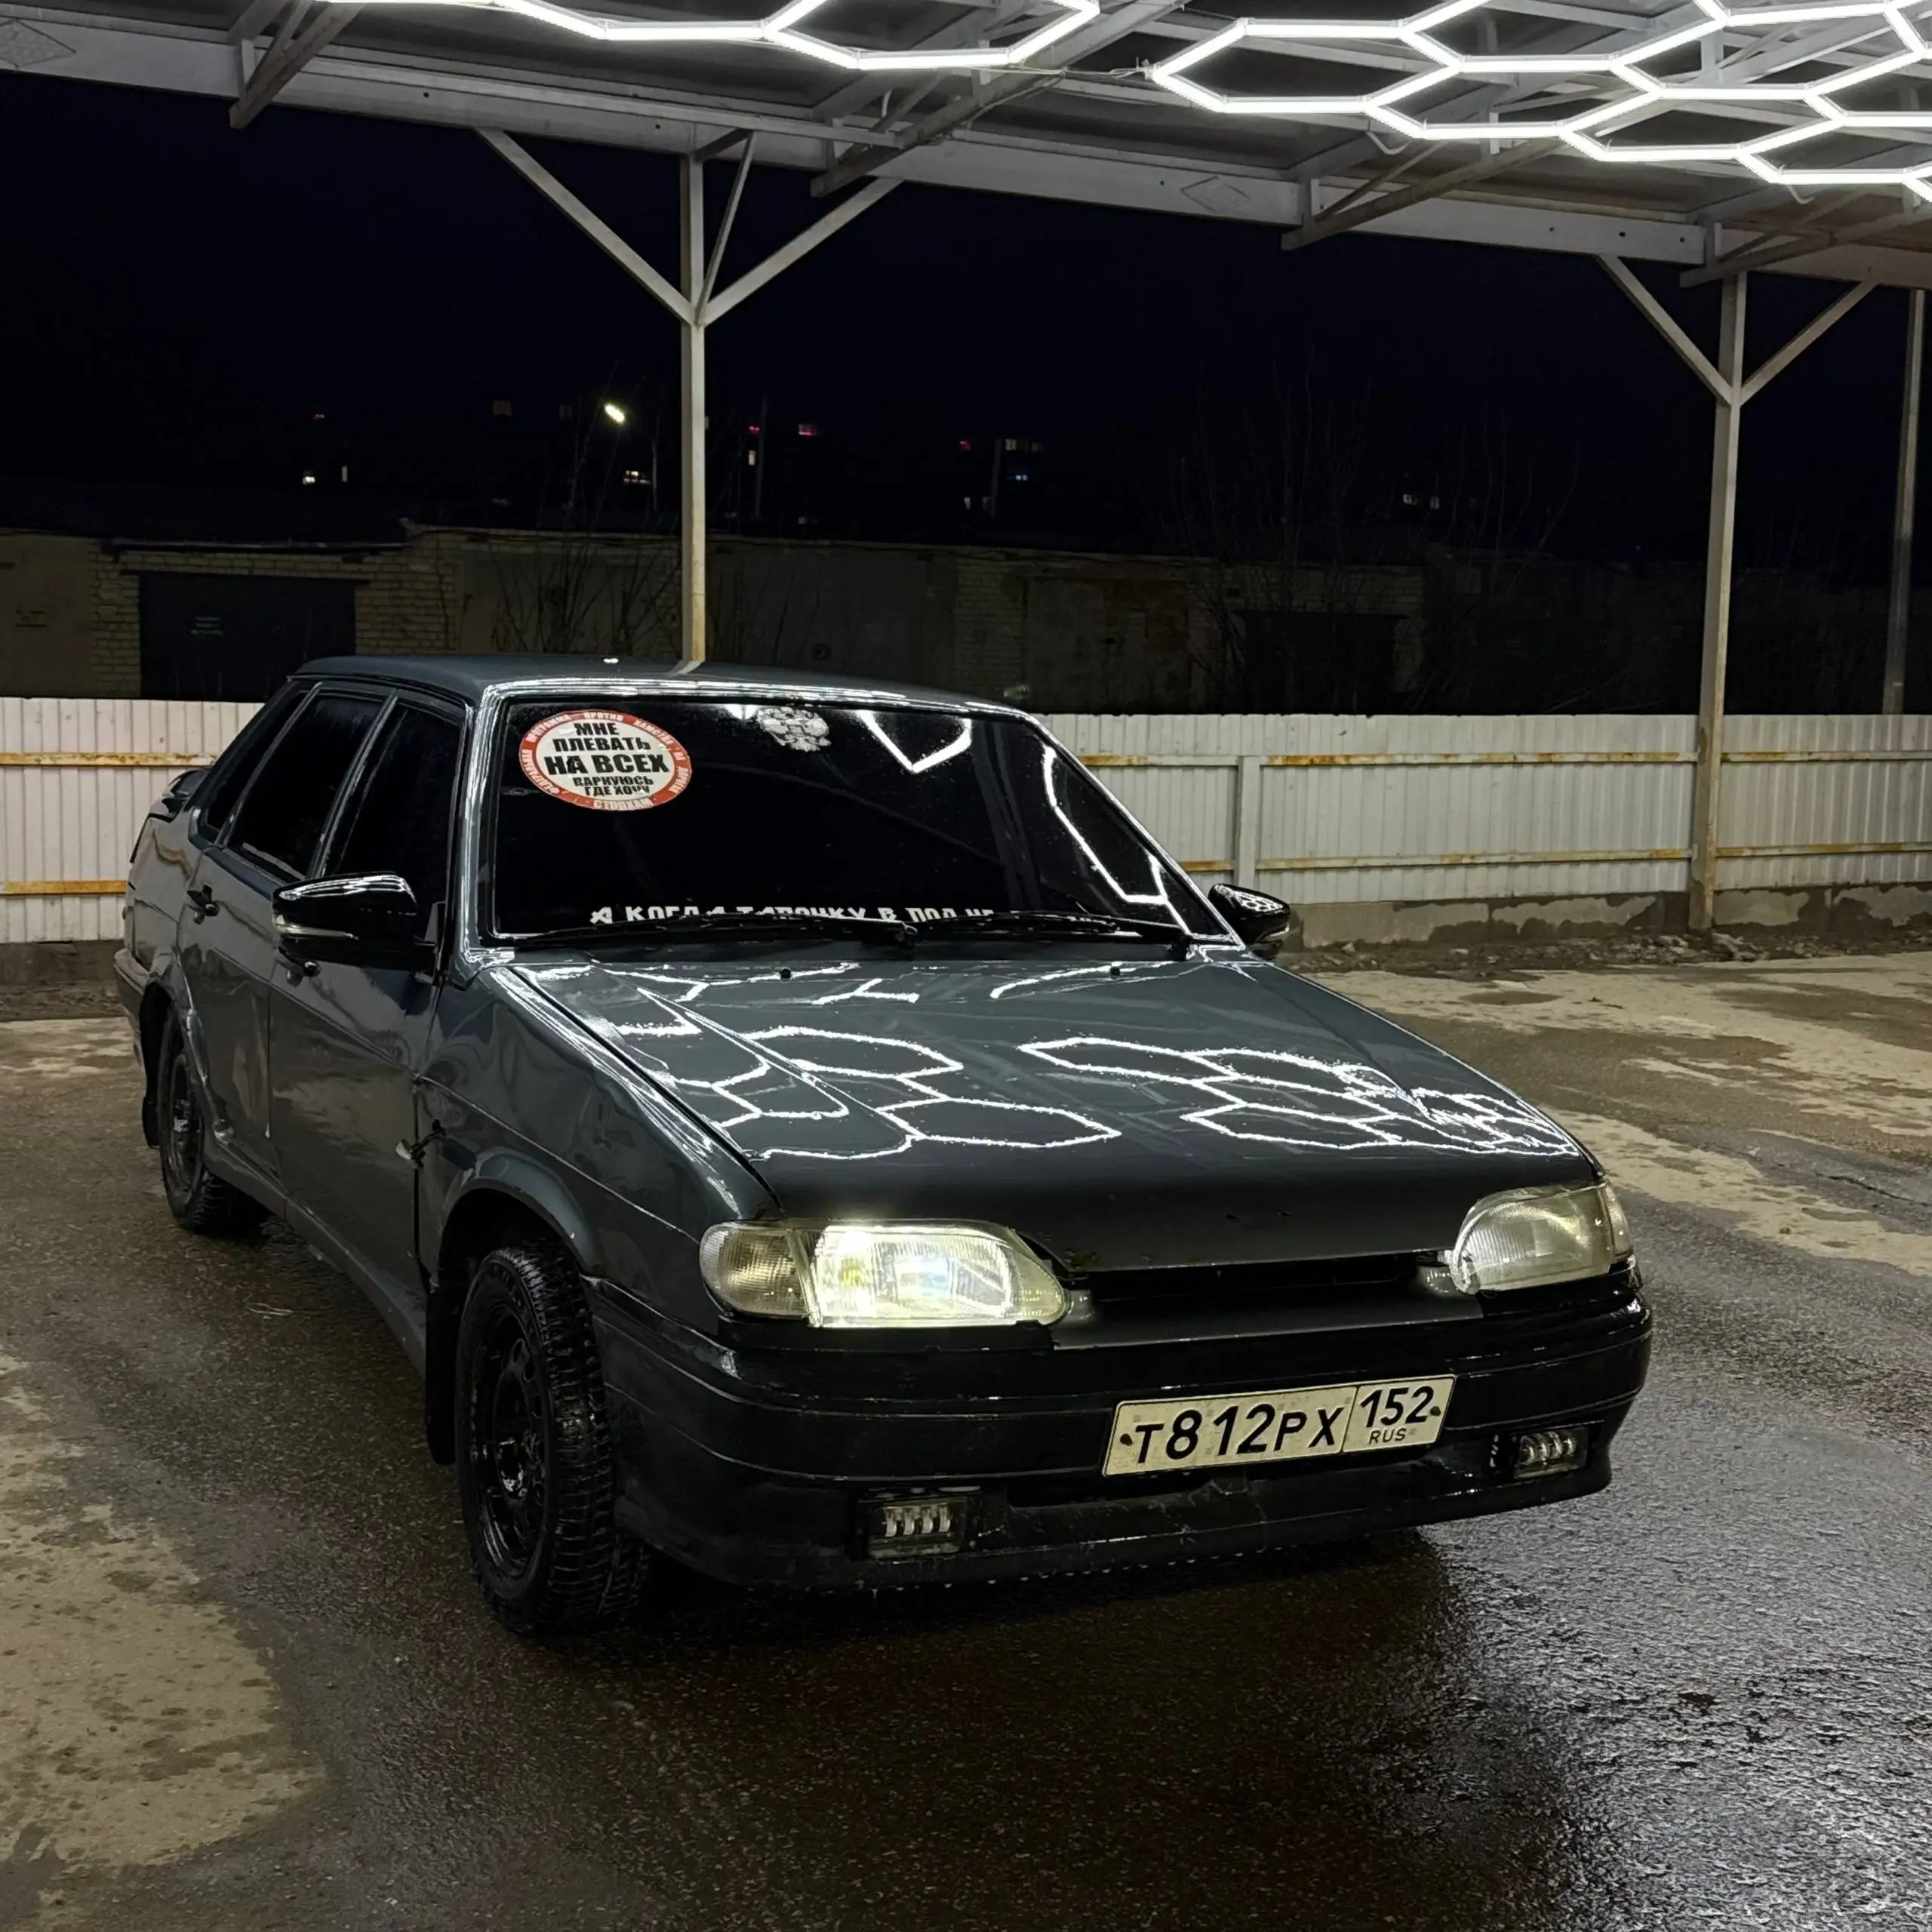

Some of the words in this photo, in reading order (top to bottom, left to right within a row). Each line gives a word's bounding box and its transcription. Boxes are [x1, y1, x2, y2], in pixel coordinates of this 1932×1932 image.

[574, 722, 620, 736] МНЕ
[552, 737, 651, 752] ПЛЕВАТЬ
[543, 755, 589, 775] НА
[592, 754, 670, 774] ВСЕХ
[584, 786, 612, 797] ГДЕ
[1135, 1402, 1344, 1464] Т812РХ
[1359, 1385, 1434, 1428] 152
[1368, 1427, 1407, 1445] RUS
